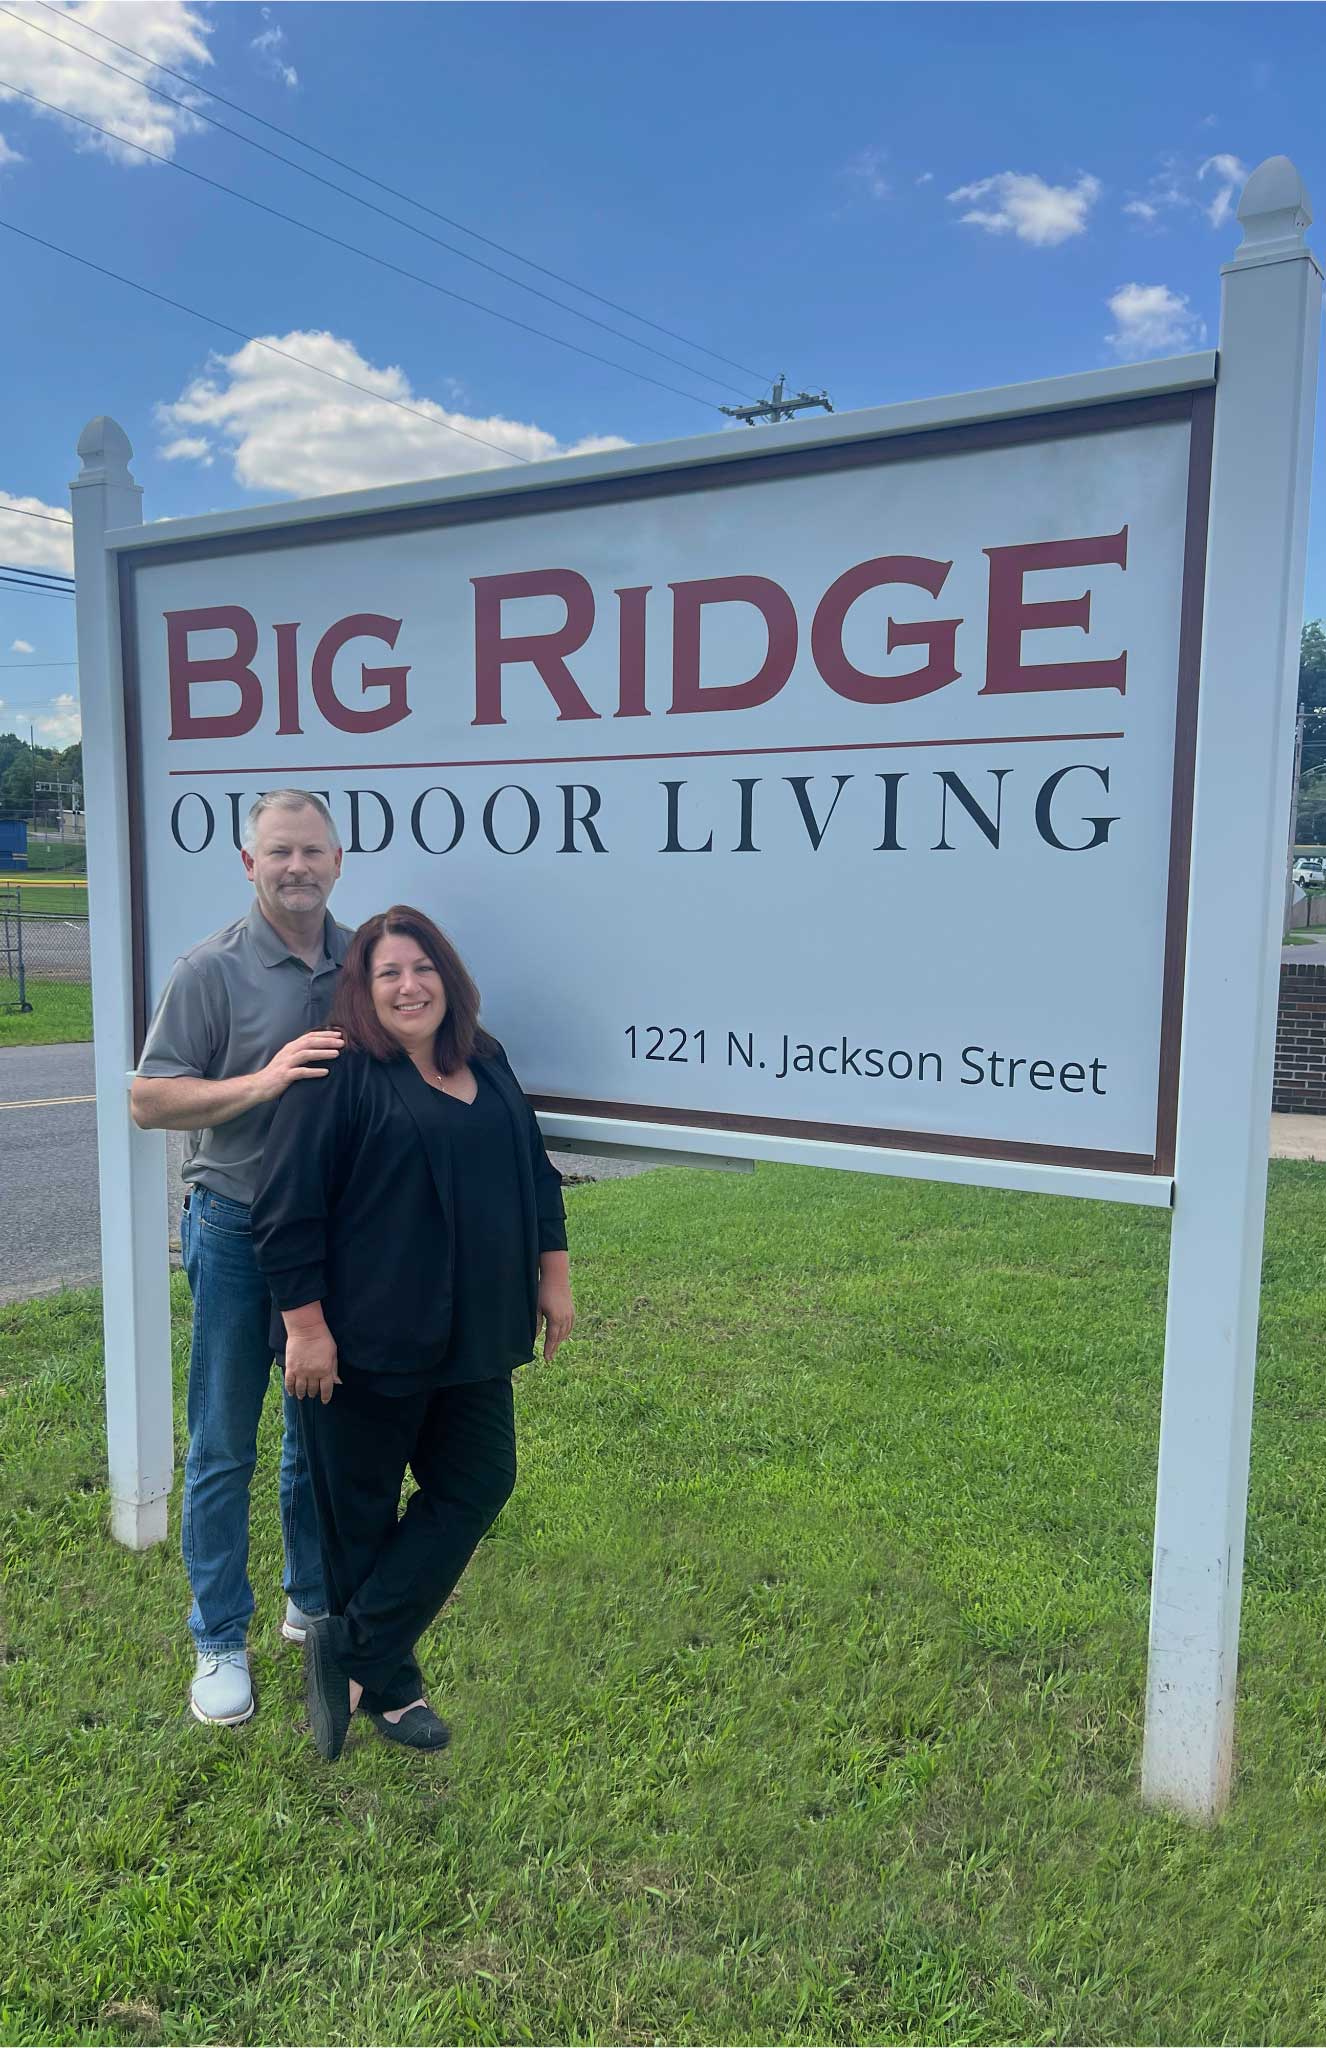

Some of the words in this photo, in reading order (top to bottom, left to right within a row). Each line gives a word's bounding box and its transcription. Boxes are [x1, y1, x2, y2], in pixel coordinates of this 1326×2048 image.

[163, 605, 412, 740] BIG
[469, 524, 1128, 725] RIDGE
[171, 784, 609, 855] OUDOOR
[658, 764, 1121, 853] LIVING
[624, 1025, 707, 1064] 1221
[727, 1031, 766, 1069] N.
[776, 1035, 943, 1082] Jackson
[959, 1045, 1107, 1095] Street
